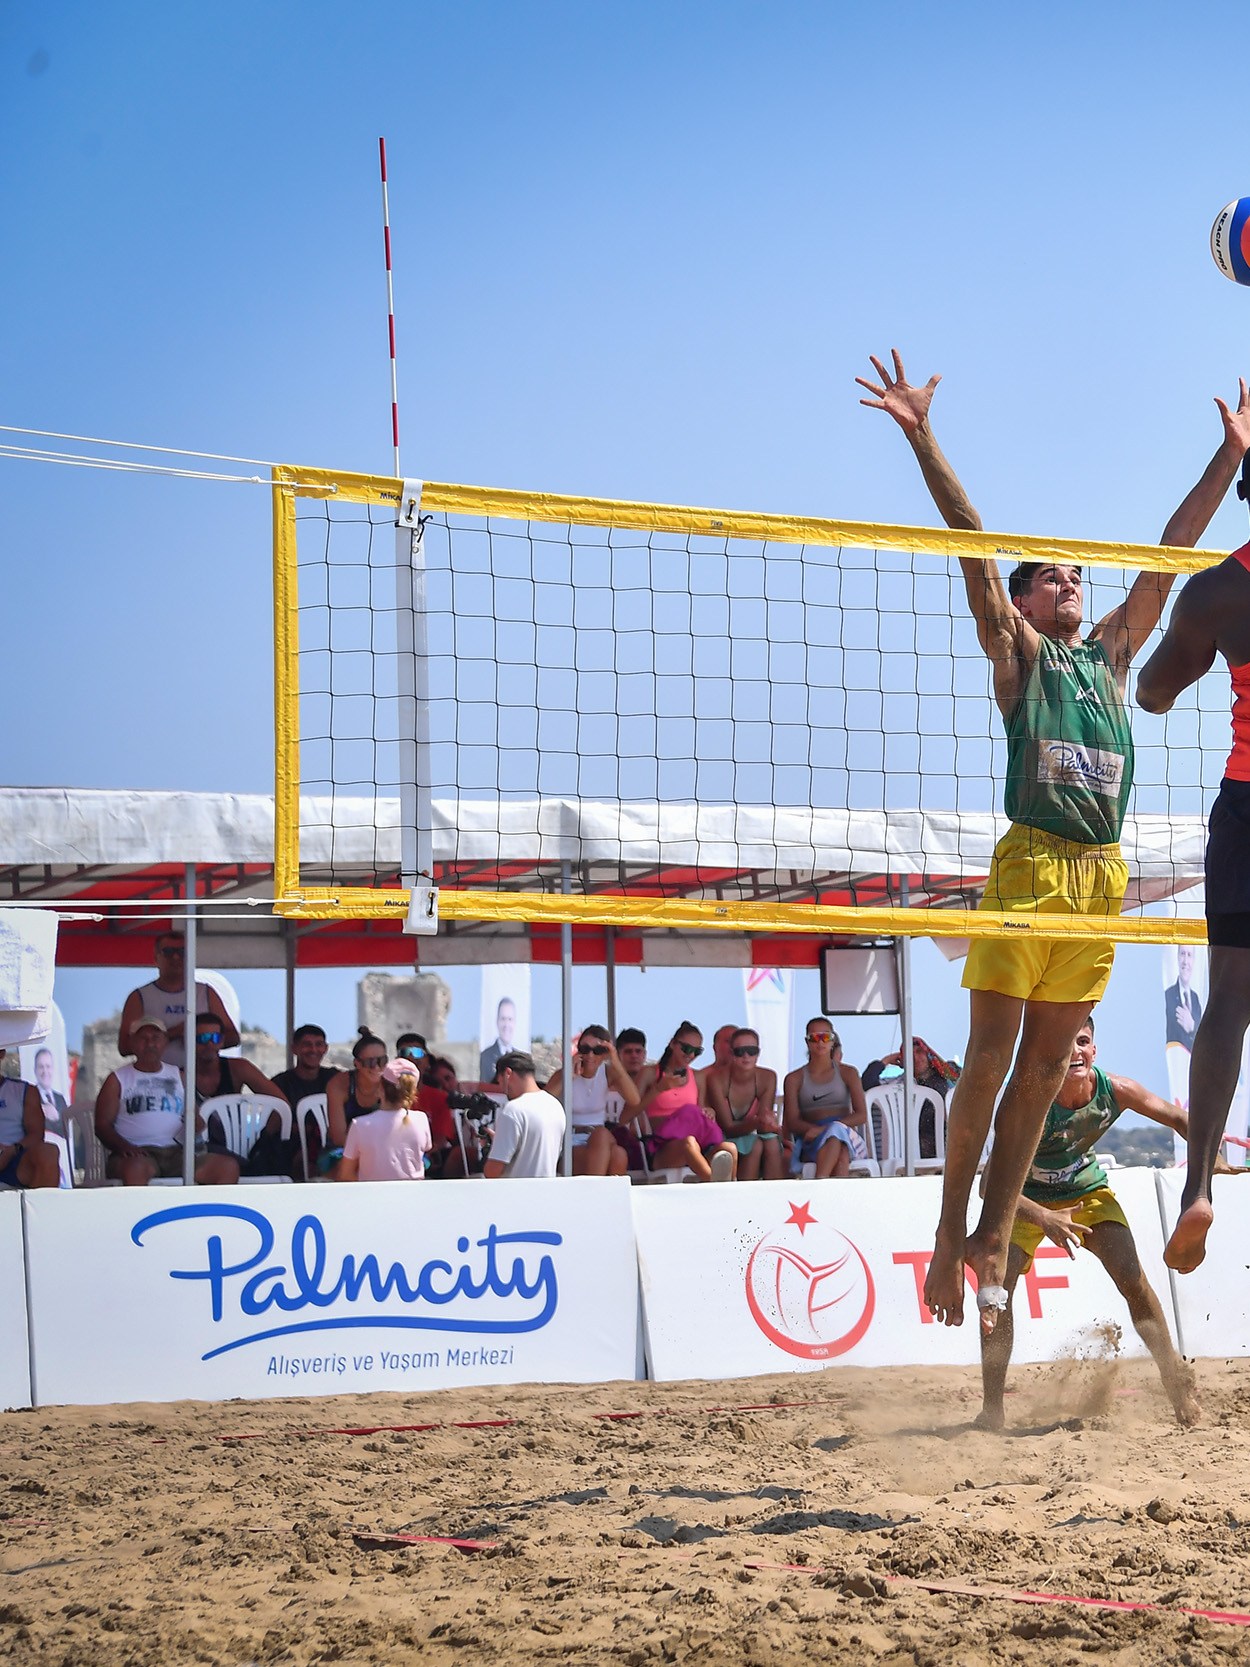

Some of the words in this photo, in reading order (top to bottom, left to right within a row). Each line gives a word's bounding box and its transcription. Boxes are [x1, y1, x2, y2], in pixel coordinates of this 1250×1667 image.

[1216, 212, 1228, 248] BEACH
[1217, 250, 1228, 270] PRO
[1049, 745, 1118, 784] Palmcity
[131, 1203, 562, 1361] Palmcity
[892, 1247, 1069, 1324] TF
[267, 1353, 346, 1378] Alışveriş
[353, 1356, 373, 1371] ve
[380, 1351, 440, 1372] Yaşam
[447, 1345, 515, 1367] Merkezi
